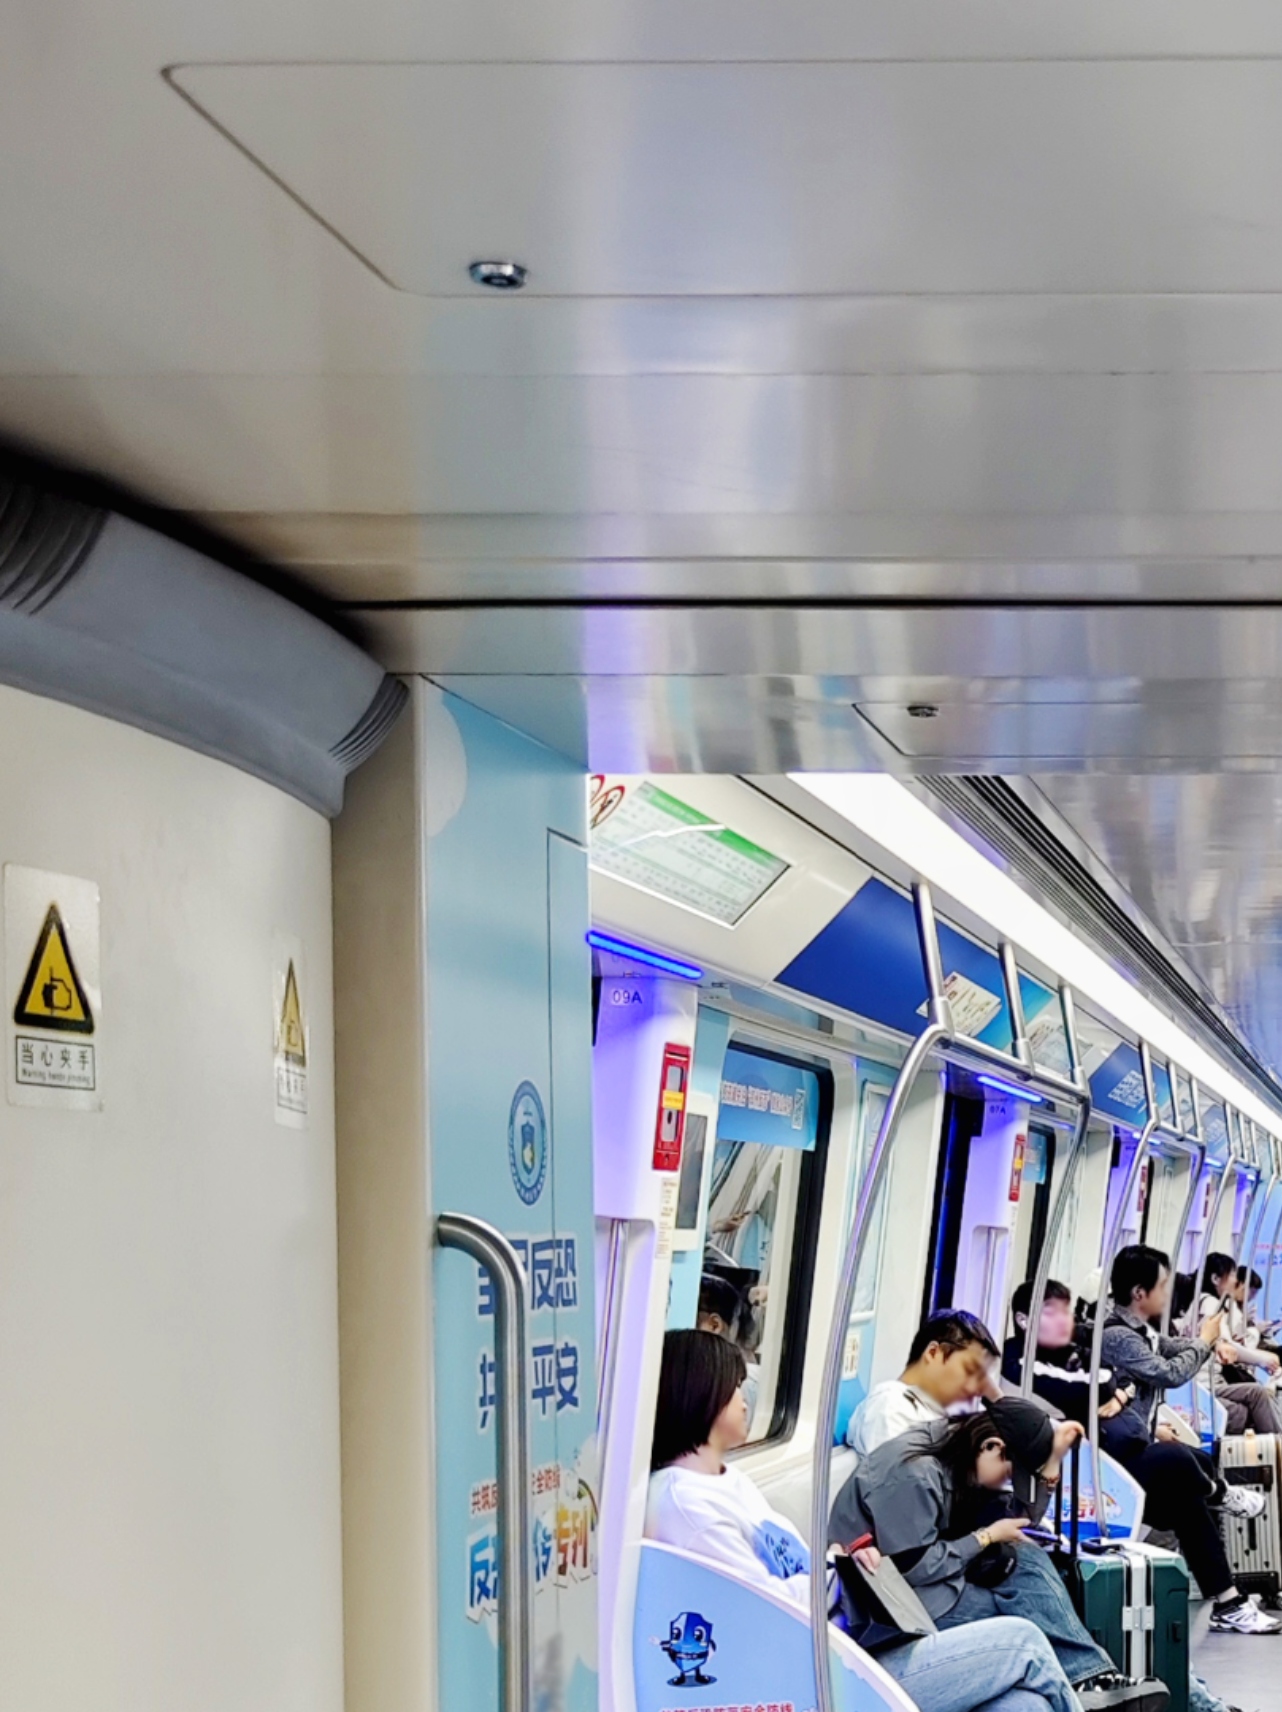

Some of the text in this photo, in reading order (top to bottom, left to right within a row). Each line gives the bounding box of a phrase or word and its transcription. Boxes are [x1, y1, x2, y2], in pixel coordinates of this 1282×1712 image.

[612, 989, 643, 1005] 09A
[21, 1041, 90, 1071] 当心夹手
